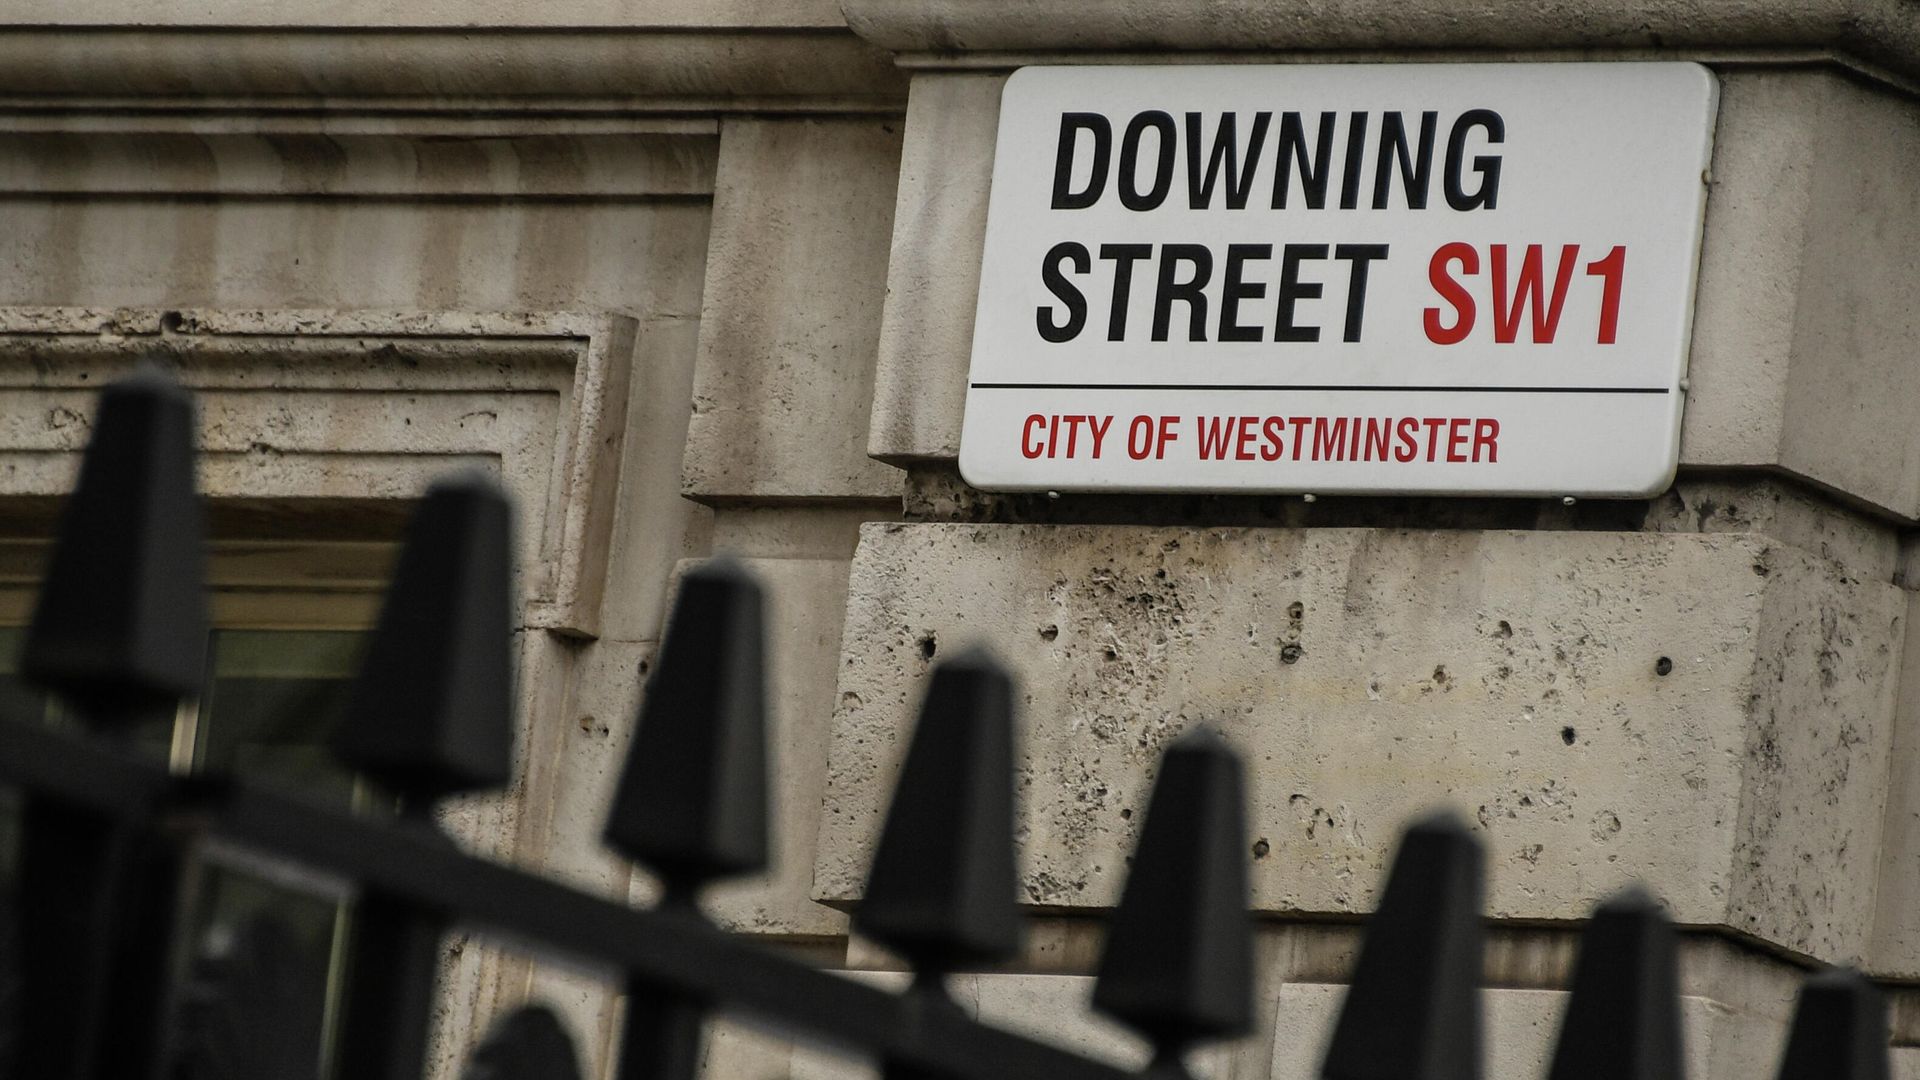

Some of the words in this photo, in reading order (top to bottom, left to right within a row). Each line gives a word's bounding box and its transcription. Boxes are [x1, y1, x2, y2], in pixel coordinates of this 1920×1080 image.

[1051, 109, 1506, 213] DOWNING
[1036, 241, 1390, 344] STREET
[1422, 241, 1627, 346] SW1
[1021, 413, 1114, 460] CITY
[1127, 414, 1181, 461] OF
[1196, 415, 1500, 464] WESTMINSTER
